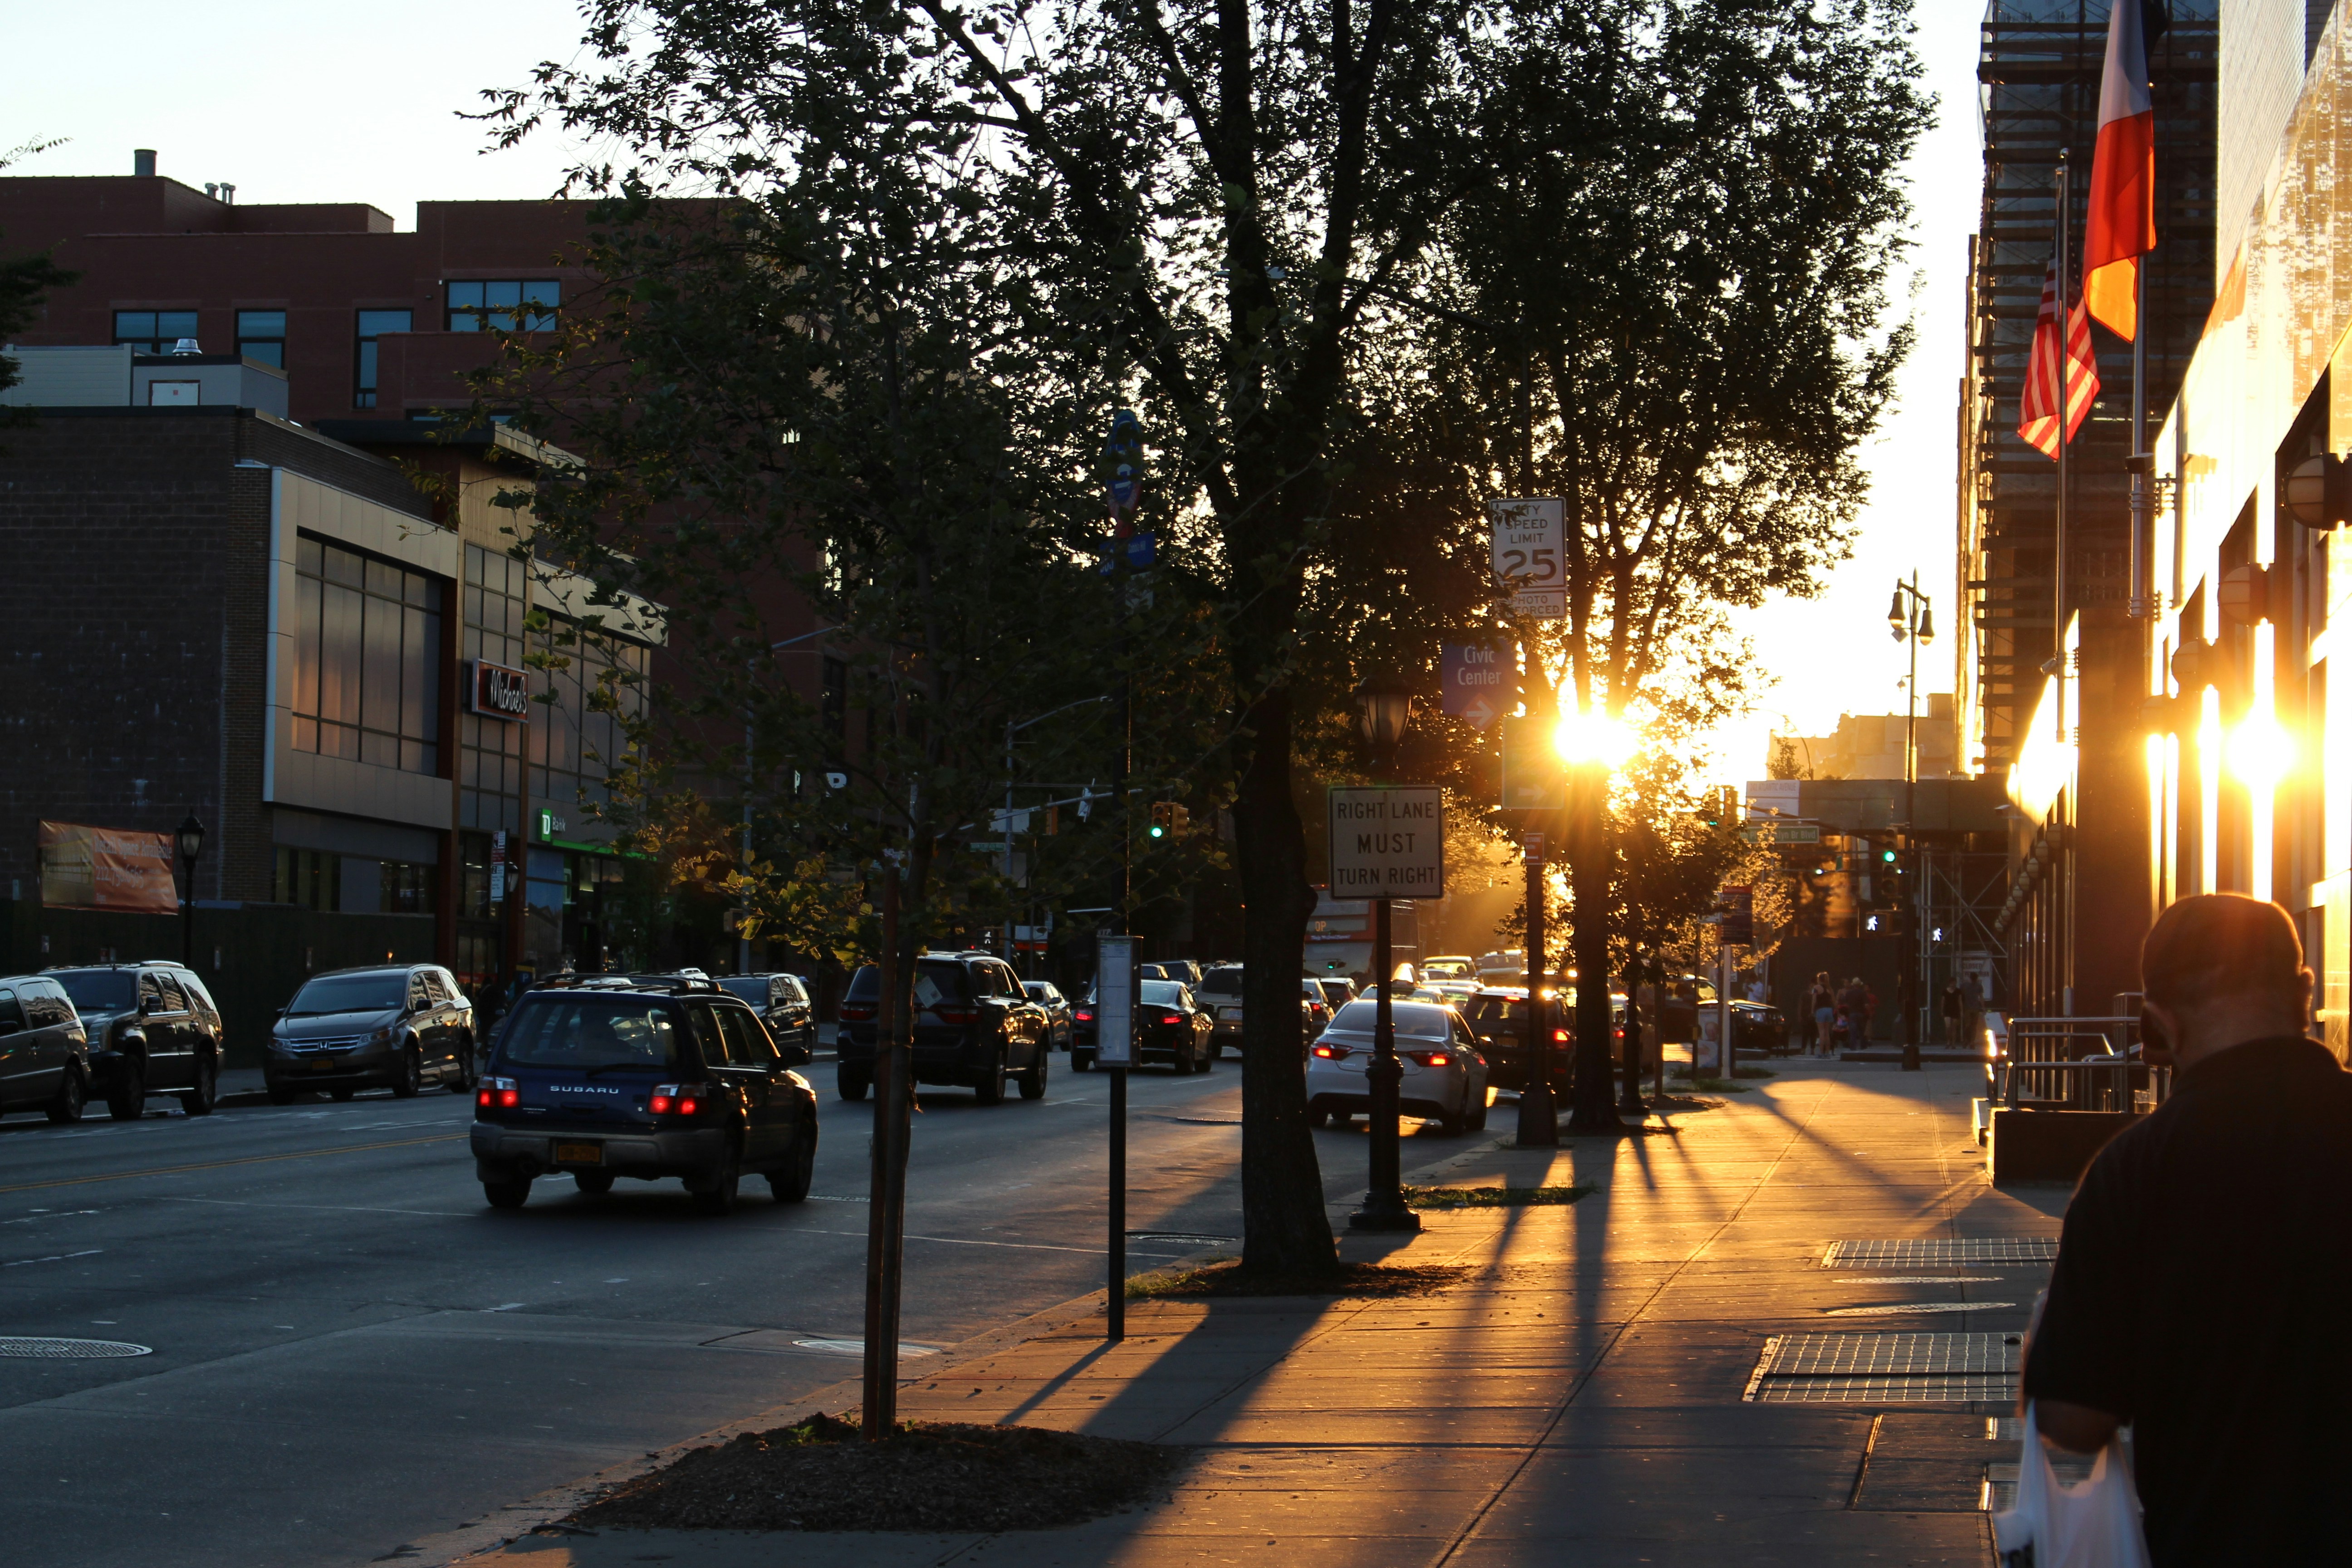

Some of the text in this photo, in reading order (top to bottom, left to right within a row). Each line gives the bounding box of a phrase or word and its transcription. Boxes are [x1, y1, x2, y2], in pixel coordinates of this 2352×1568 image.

[1510, 533, 1544, 544] LIMIT
[1502, 549, 1557, 581] 25
[1464, 646, 1495, 664] Civic
[1457, 667, 1501, 685] Center
[490, 669, 527, 714] Michaels
[1758, 783, 1778, 791] ATLANTIC
[1779, 783, 1796, 791] AVENUE
[1338, 802, 1434, 819] RIGHT LANE
[542, 814, 566, 835] TD Bank
[1357, 833, 1416, 854] MUST
[1800, 830, 1816, 839] Blvd
[118, 838, 139, 859] Space
[141, 840, 172, 859] Available
[1337, 867, 1436, 885] TURN RIGHT
[550, 1085, 619, 1094] SUBARU
